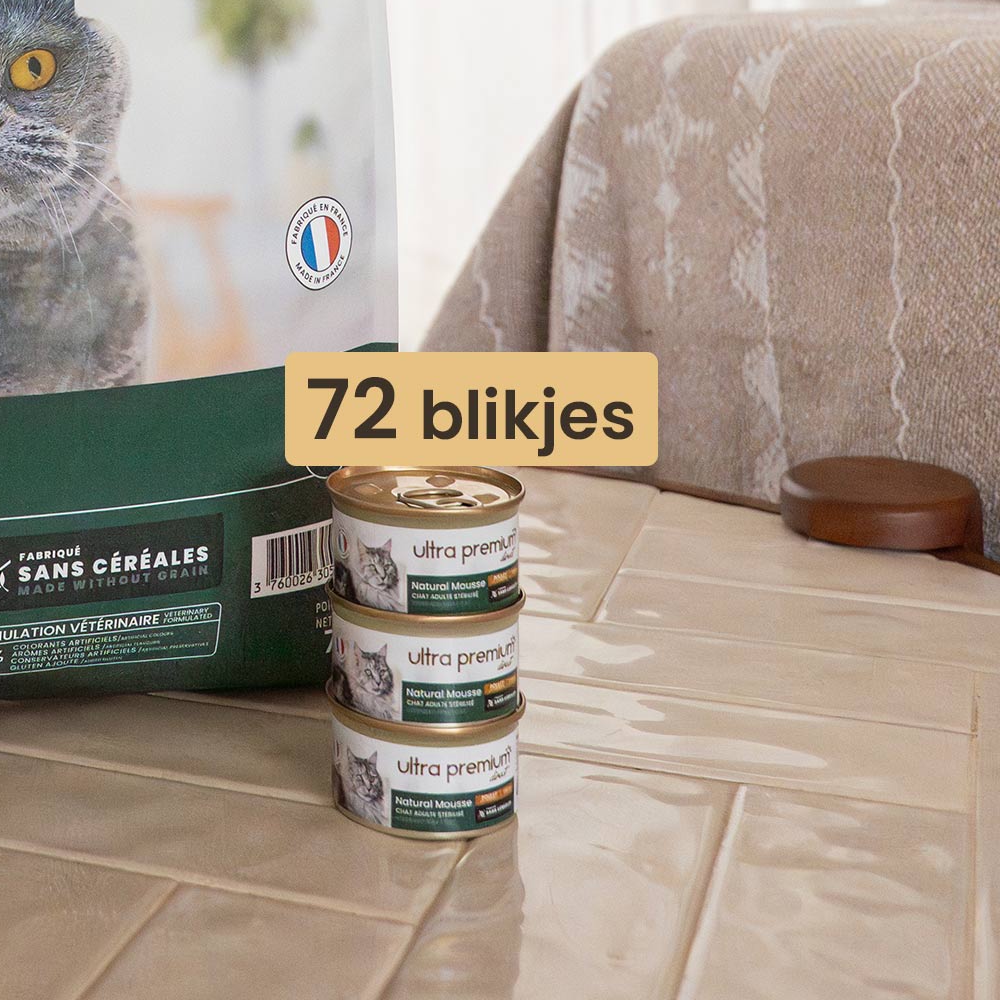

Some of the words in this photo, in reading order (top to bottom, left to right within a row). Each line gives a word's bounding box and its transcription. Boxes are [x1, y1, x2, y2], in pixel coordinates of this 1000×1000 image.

[291, 203, 318, 245] FABRIQUÉ
[319, 203, 329, 211] EN
[330, 205, 348, 237] FRANCE
[295, 262, 313, 283] MADE
[313, 276, 321, 284] IN
[321, 254, 345, 283] FRANCE
[19, 545, 81, 561] FABRIQUÉ
[413, 540, 456, 559] ultra
[462, 535, 516, 565] premium
[18, 561, 84, 582] SANS
[93, 546, 209, 574] CÉRÉALES
[17, 582, 65, 596] MADE
[72, 572, 151, 591] WITHOUT
[157, 565, 209, 581] GRAIN
[254, 582, 261, 593] 3
[270, 573, 313, 591] 760026
[411, 581, 450, 591] Natural
[451, 579, 486, 590] Mousse
[163, 612, 213, 624] FORMULATED
[164, 607, 209, 618] VETERINARY
[70, 614, 160, 633] VÉTÉRINAIRE
[11, 648, 48, 658] ARÔMES
[51, 645, 100, 656] ARTIFICIELS
[13, 640, 66, 650] COLORANTS
[11, 652, 85, 665] CONSERVATEURS
[87, 646, 136, 658] ARTIFICIELS
[408, 647, 452, 666] ultra
[458, 642, 515, 672] premium
[9, 663, 44, 671] GLUTEN
[406, 687, 444, 698] Natural
[446, 688, 482, 699] Mousse
[397, 756, 440, 776] ultra
[446, 751, 511, 783] premium
[395, 796, 433, 808] Natural
[435, 799, 472, 809] Mousse
